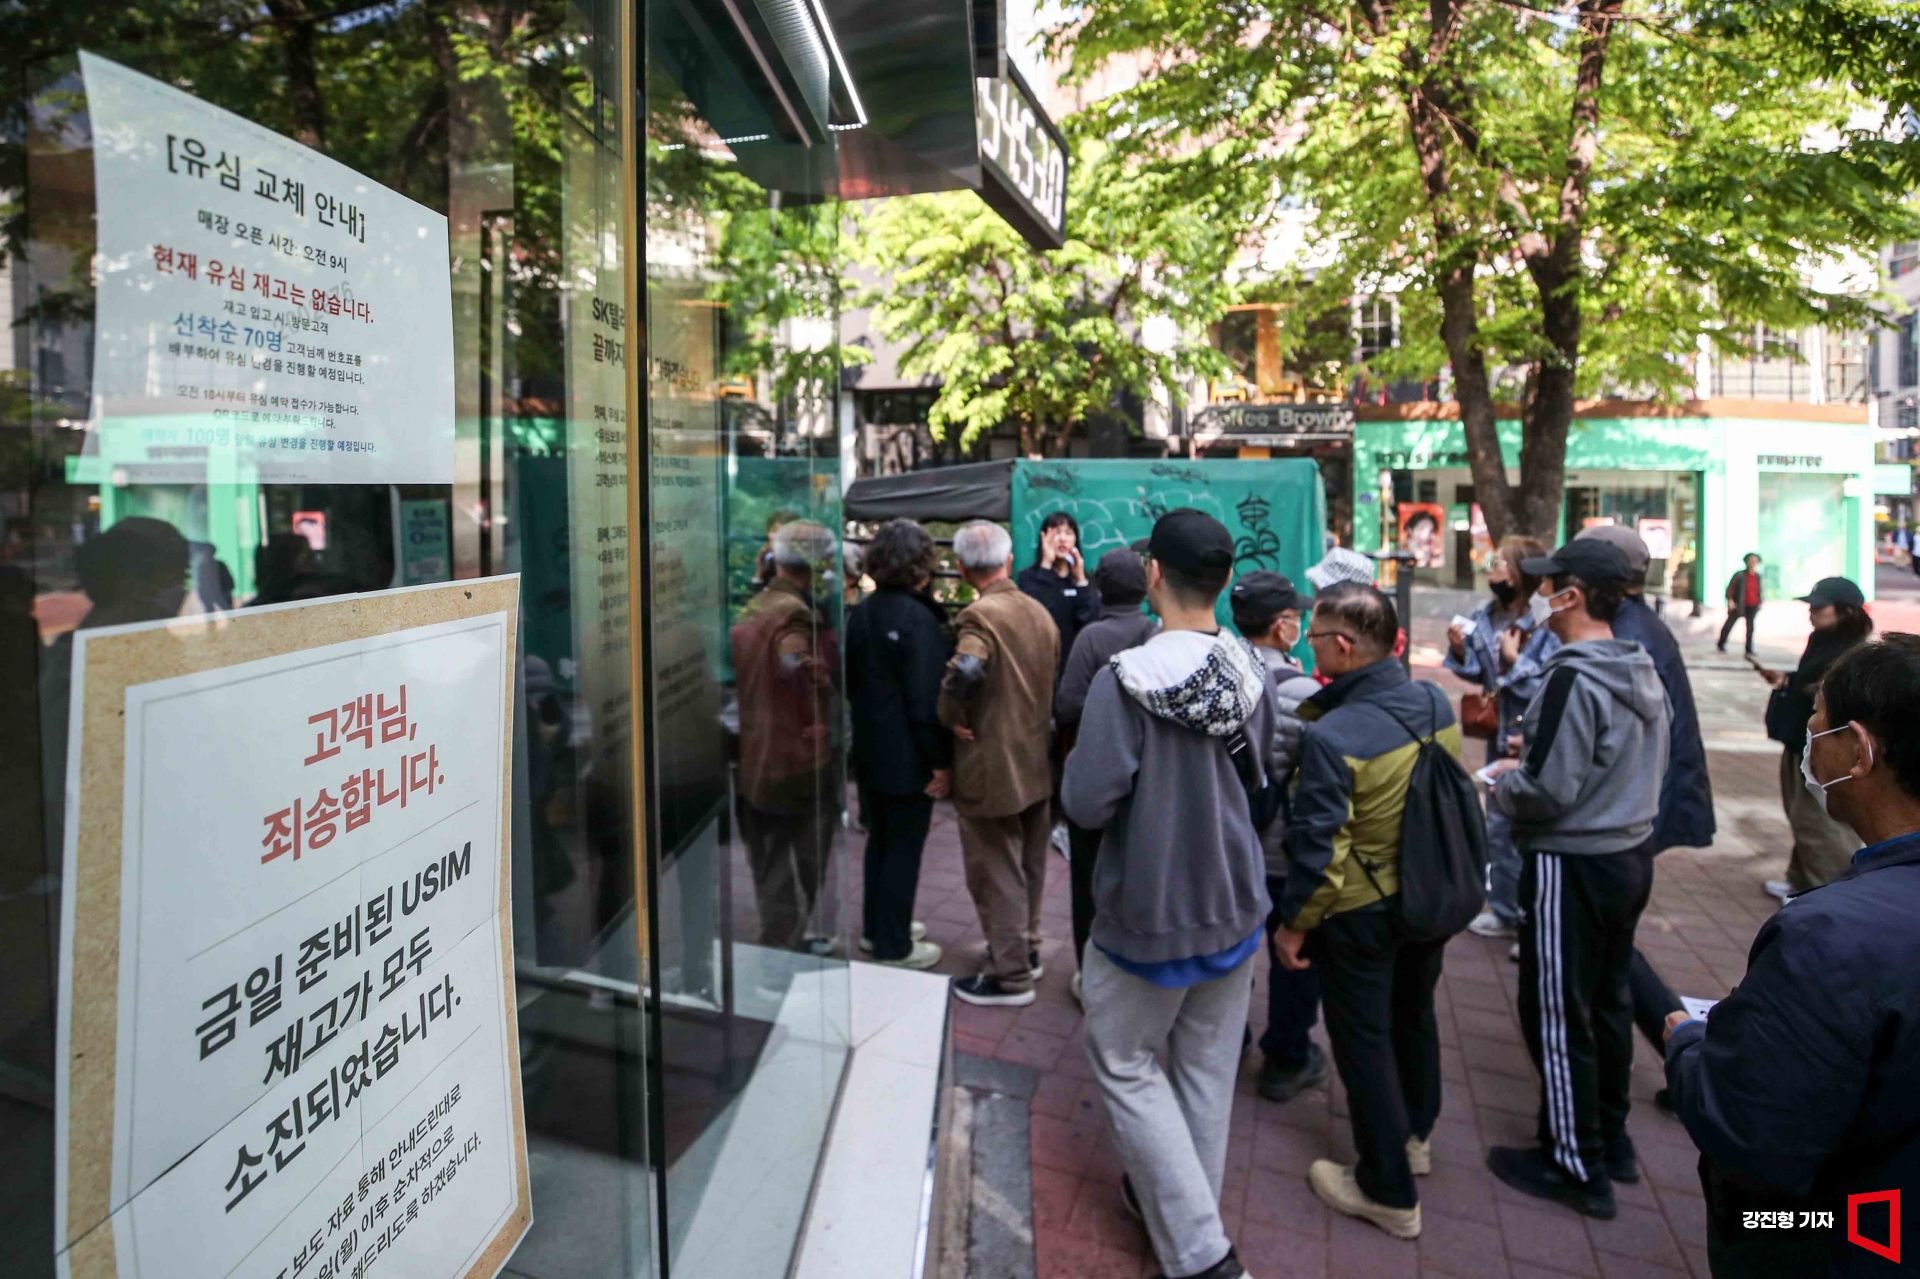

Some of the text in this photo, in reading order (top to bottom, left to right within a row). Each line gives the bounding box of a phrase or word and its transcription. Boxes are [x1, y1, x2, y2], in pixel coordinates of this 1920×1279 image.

[167, 134, 366, 243] [유심 교체 안내]
[198, 210, 229, 235] 매장
[234, 221, 262, 245] 오픈
[303, 245, 327, 266] 오전
[329, 254, 348, 274] 9시
[153, 244, 198, 280] 현재
[206, 259, 245, 291] 유심
[252, 271, 306, 307] 재고는
[311, 287, 375, 324] 없습니다.
[223, 300, 247, 318] 재고
[250, 305, 273, 323] 입고
[174, 311, 362, 368] 선착순 70명 고객님께 번호표를
[225, 350, 248, 368] 유심
[270, 395, 289, 410] 예약
[304, 684, 418, 767] 고객님,
[260, 744, 445, 865] 죄송합니다.
[194, 841, 472, 1062] 금일 준비된 USIM
[262, 926, 434, 1086] 재고가 모두
[224, 974, 463, 1215] 소진되었습니다.
[327, 1192, 356, 1238] 자료
[357, 1158, 386, 1202] 통해
[388, 1084, 463, 1165] 안내드린대로
[361, 1193, 390, 1233] 이후
[392, 1124, 456, 1203] 순차적으로
[421, 1131, 483, 1207] 하겠습니다.
